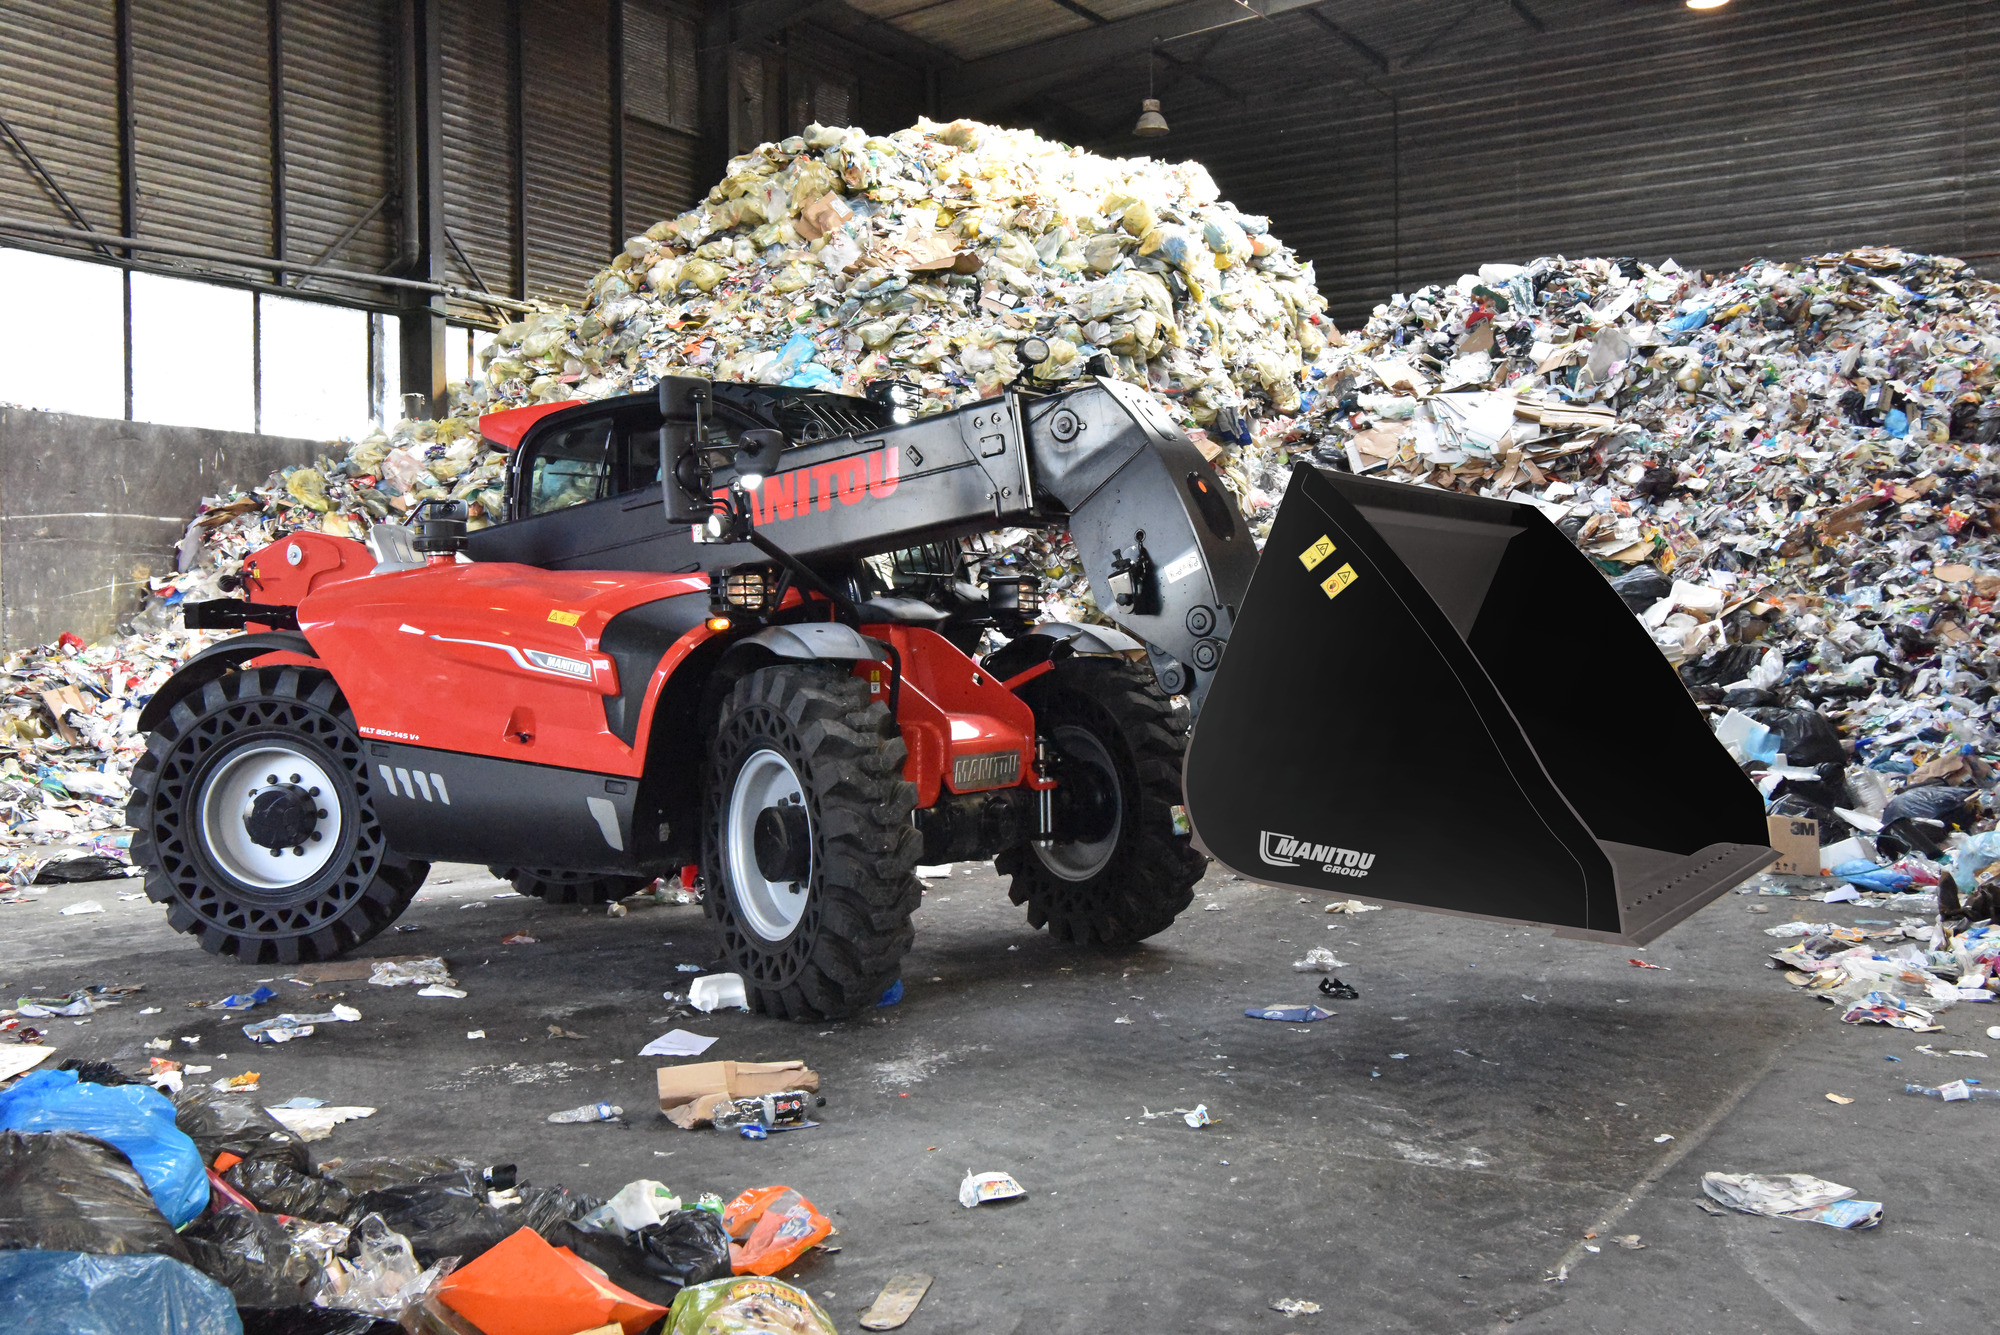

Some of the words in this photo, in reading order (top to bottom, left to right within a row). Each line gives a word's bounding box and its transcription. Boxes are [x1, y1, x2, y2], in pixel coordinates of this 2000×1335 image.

[712, 446, 899, 527] NITOU
[547, 656, 588, 674] MANITOU
[359, 726, 376, 734] MLT
[375, 728, 408, 739] 850-145
[1790, 821, 1815, 836] 3M
[1273, 837, 1377, 870] MANITOU
[1322, 864, 1369, 878] GROUP
